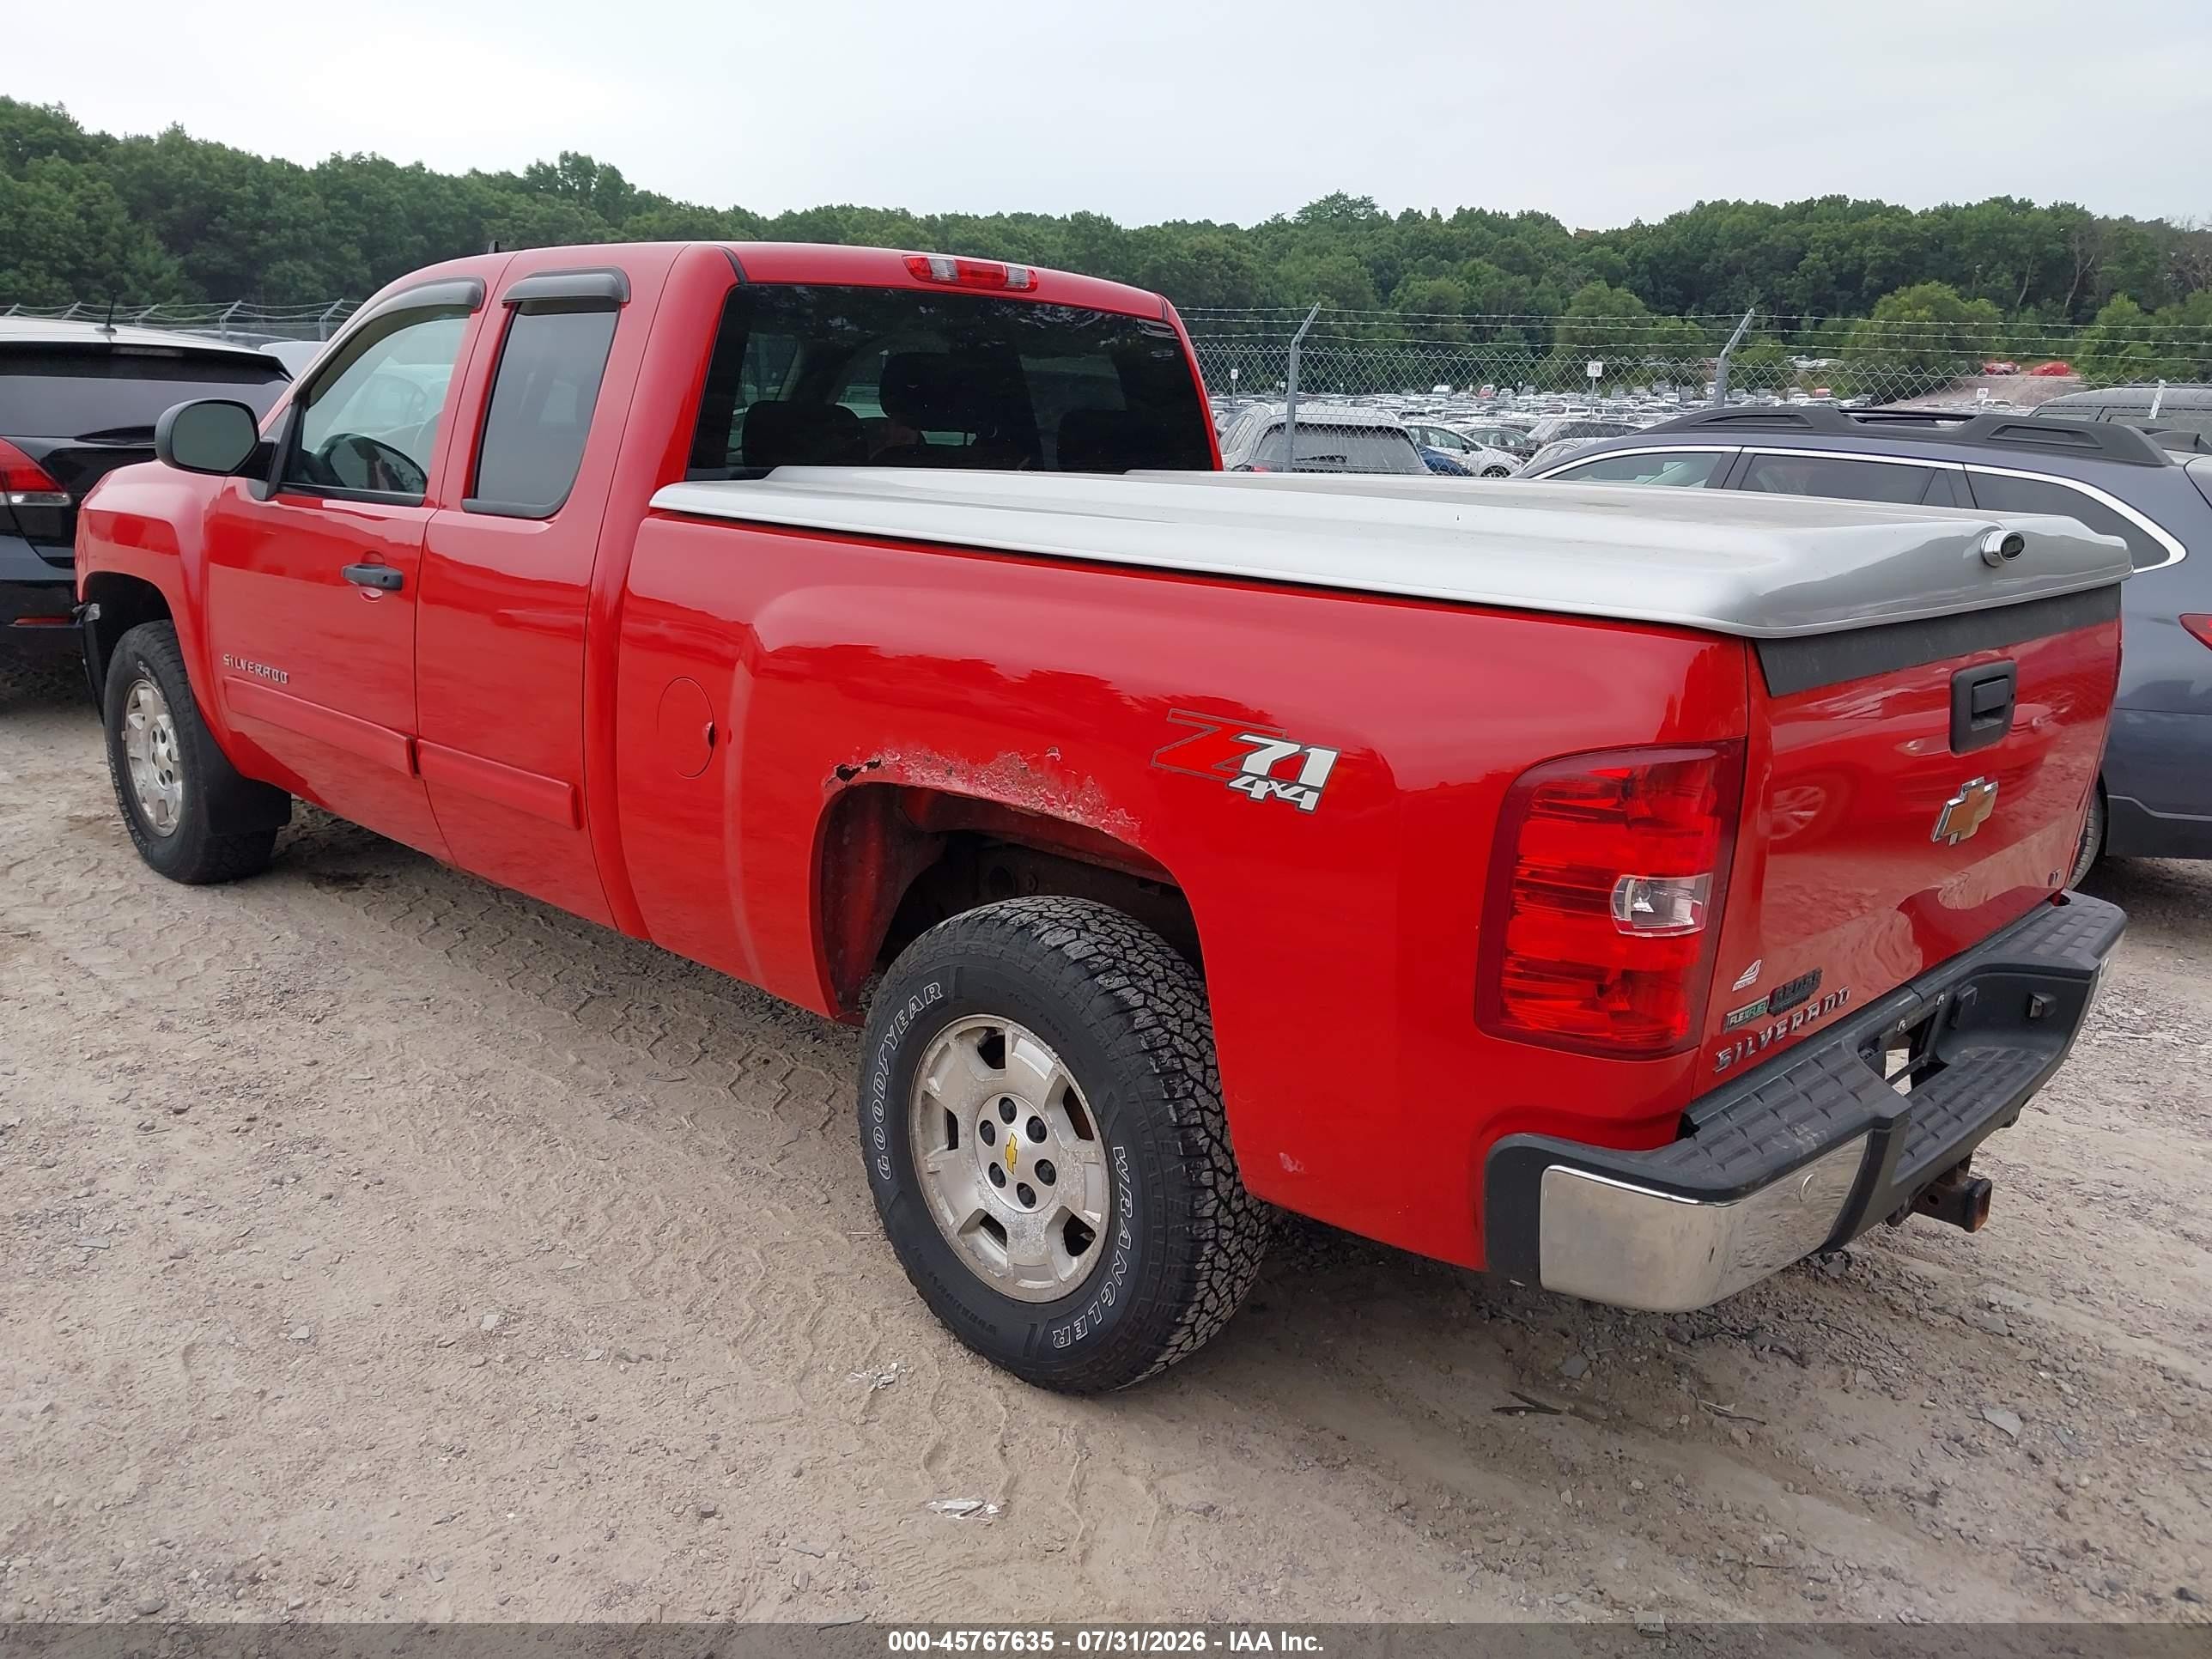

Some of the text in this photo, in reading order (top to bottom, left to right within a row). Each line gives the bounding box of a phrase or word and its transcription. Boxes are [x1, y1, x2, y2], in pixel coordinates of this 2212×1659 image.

[222, 653, 289, 684] SILVERADO
[1151, 708, 1340, 789] Z71
[1714, 987, 1850, 1073] SILVERADO
[872, 981, 943, 1181] GOODYEAR
[1052, 1146, 1133, 1349] WRANGLER
